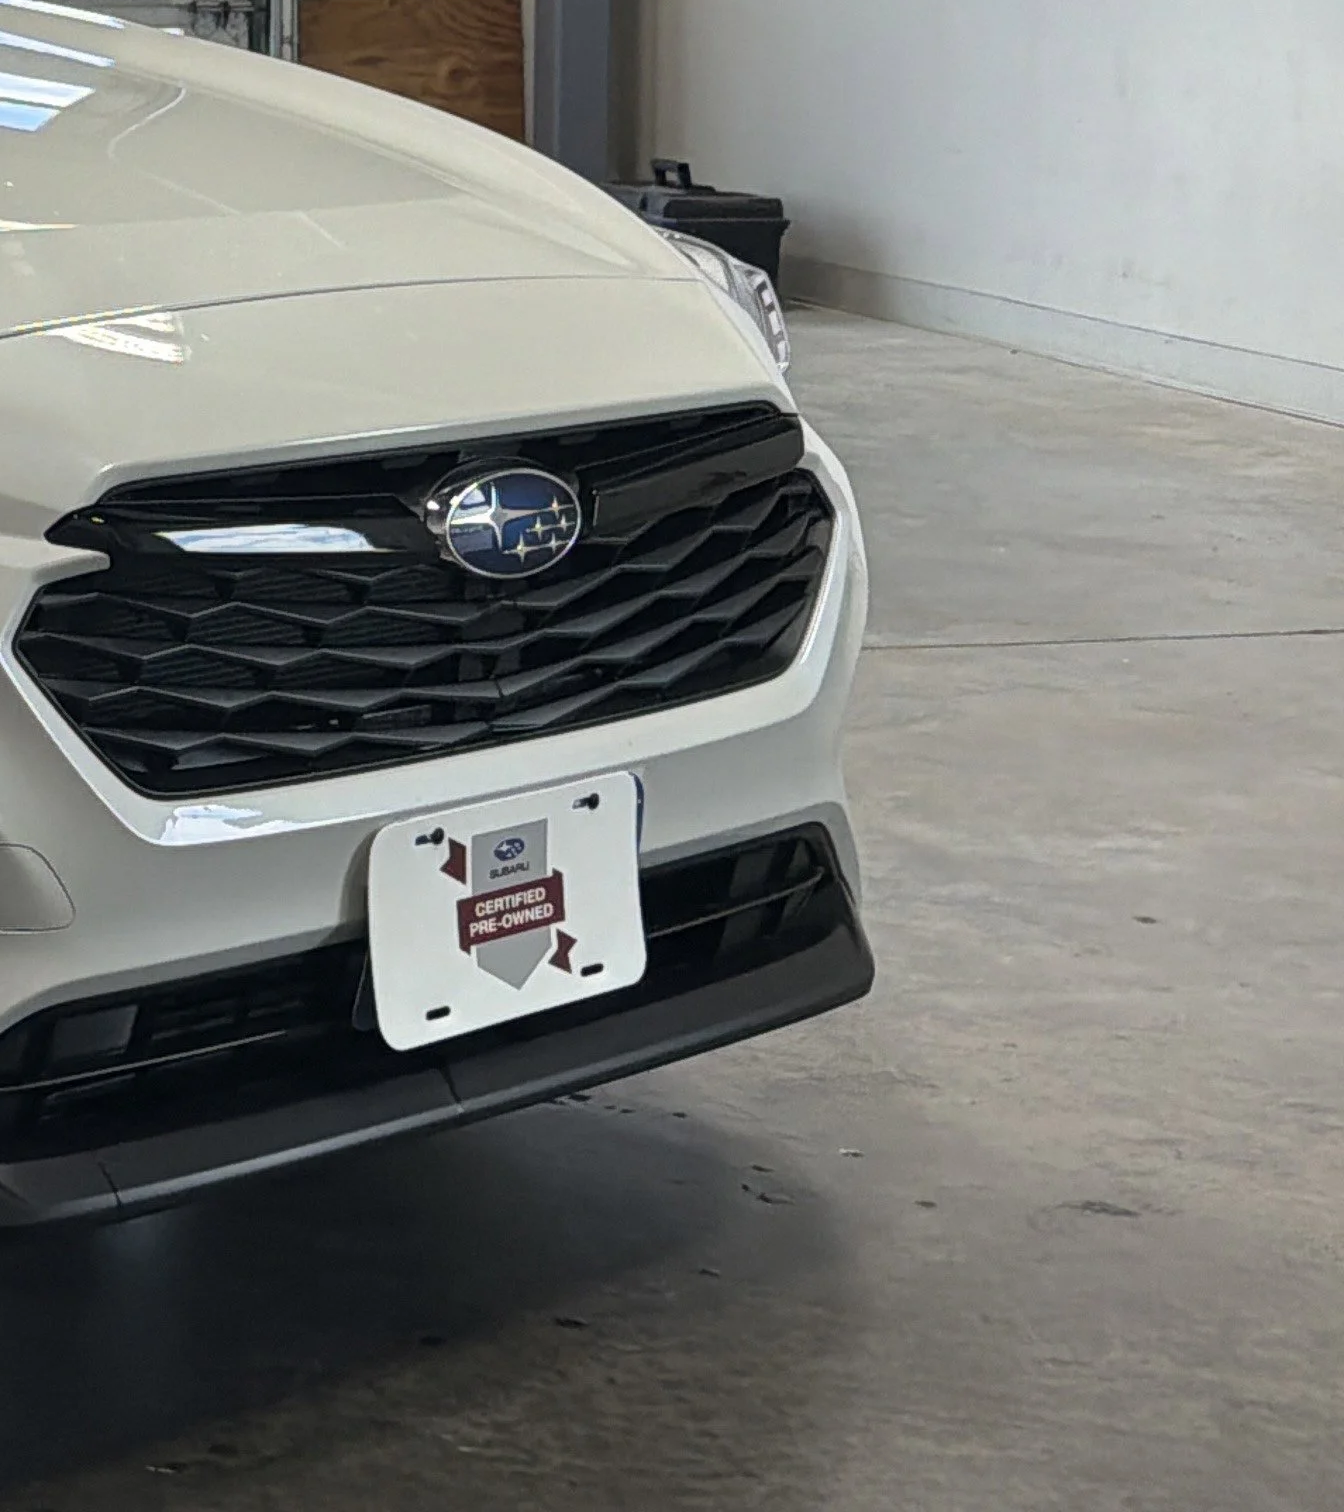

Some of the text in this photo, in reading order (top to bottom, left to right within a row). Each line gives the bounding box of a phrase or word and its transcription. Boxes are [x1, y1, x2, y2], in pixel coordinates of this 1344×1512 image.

[489, 861, 530, 880] SUBARU
[474, 886, 547, 918] CERTIFIED
[469, 902, 555, 938] PRE-OWNED
